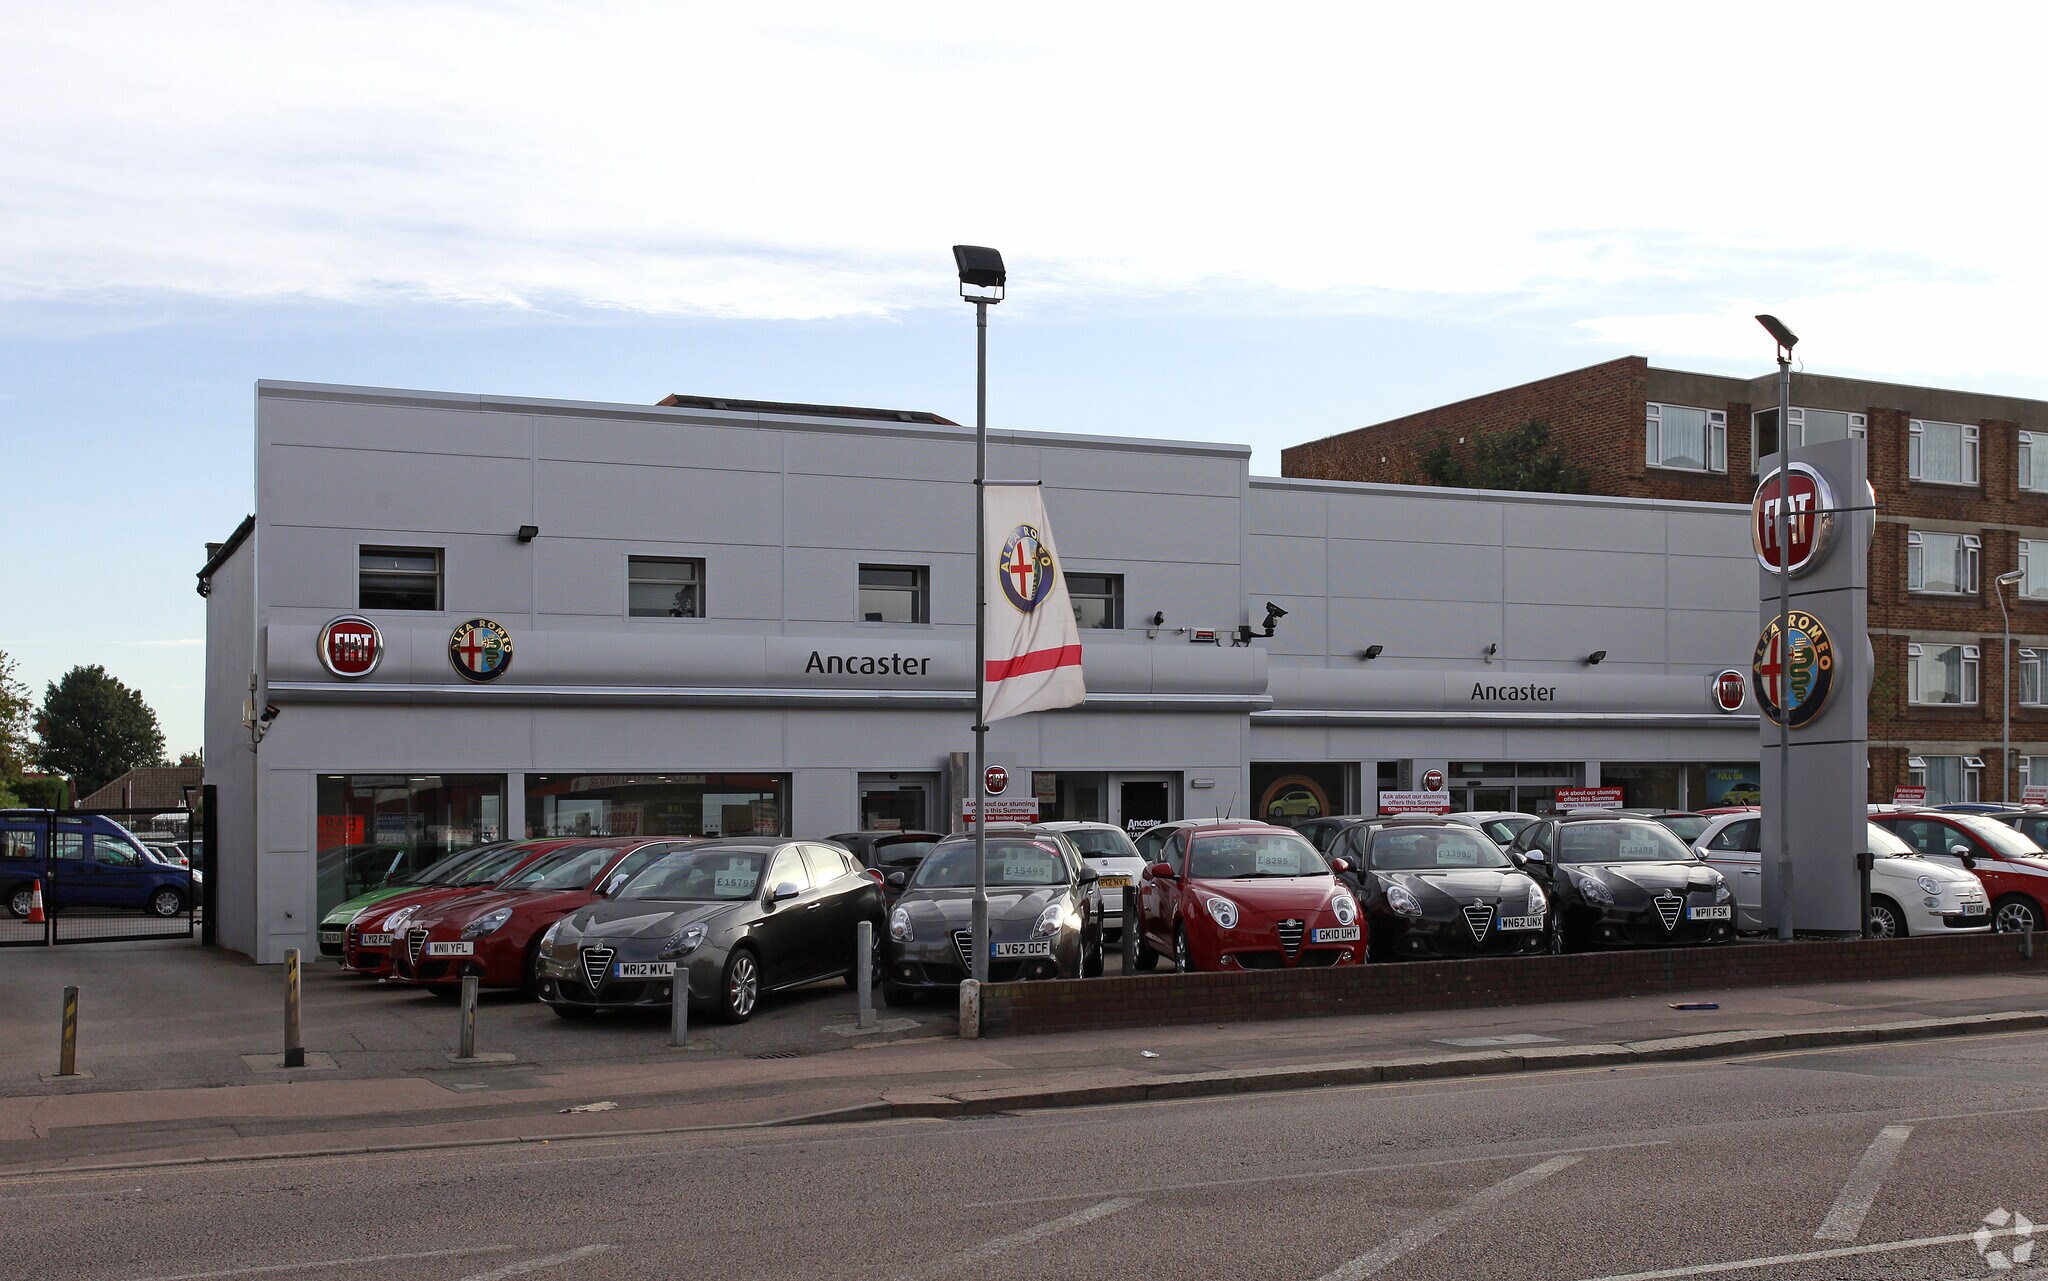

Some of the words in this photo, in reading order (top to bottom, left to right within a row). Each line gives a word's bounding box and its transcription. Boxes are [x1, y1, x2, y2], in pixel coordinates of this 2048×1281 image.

[1764, 492, 1811, 549] FIAT
[1001, 532, 1020, 573] ALFA
[1023, 526, 1051, 567] ROEO
[452, 624, 473, 650] ALFA
[479, 619, 511, 653] ROMEO
[334, 633, 372, 661] FIAT
[1754, 623, 1779, 672] ALFA
[1788, 614, 1832, 671] ROMEO
[805, 651, 931, 676] Ancaster
[1470, 682, 1557, 701] Ancaster
[1127, 818, 1162, 831] Ancaster
[1695, 908, 1711, 918] WP11
[1712, 907, 1727, 917] FSK
[1502, 917, 1525, 928] WN62
[1527, 917, 1542, 927] UNX
[364, 934, 378, 944] LY12
[379, 934, 392, 944] FXL
[1319, 929, 1340, 940] GK10
[1341, 928, 1357, 939] UHY
[433, 943, 449, 954] WN11
[451, 943, 468, 953] YFL
[997, 943, 1026, 955] LV62
[1028, 942, 1048, 954] OCF
[623, 964, 648, 975] WR12
[649, 963, 672, 975] MVL
